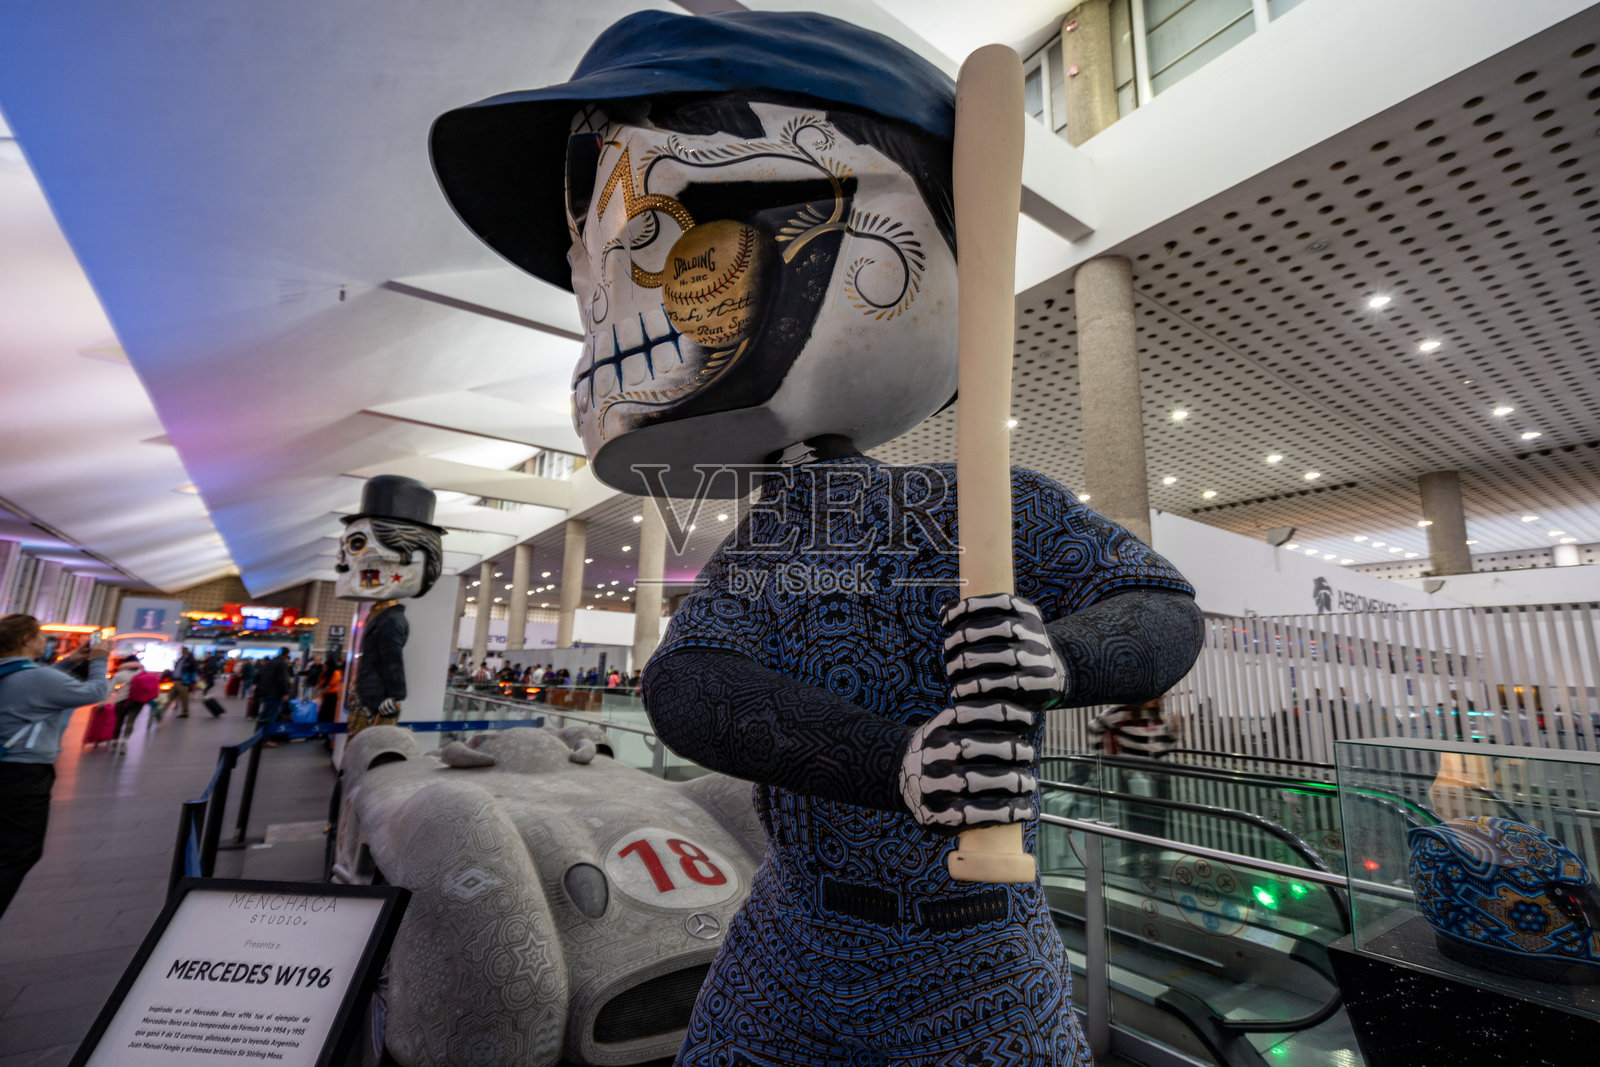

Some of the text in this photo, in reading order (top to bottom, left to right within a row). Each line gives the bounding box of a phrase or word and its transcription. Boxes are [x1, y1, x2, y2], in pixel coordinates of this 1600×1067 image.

[673, 247, 716, 280] SPALDING
[698, 326, 724, 336] Run
[618, 838, 728, 894] 18
[228, 893, 337, 913] MENCHACA
[244, 940, 274, 950] Presenta
[166, 959, 334, 988] MERCEDES W196
[192, 1008, 219, 1017] Mercedes
